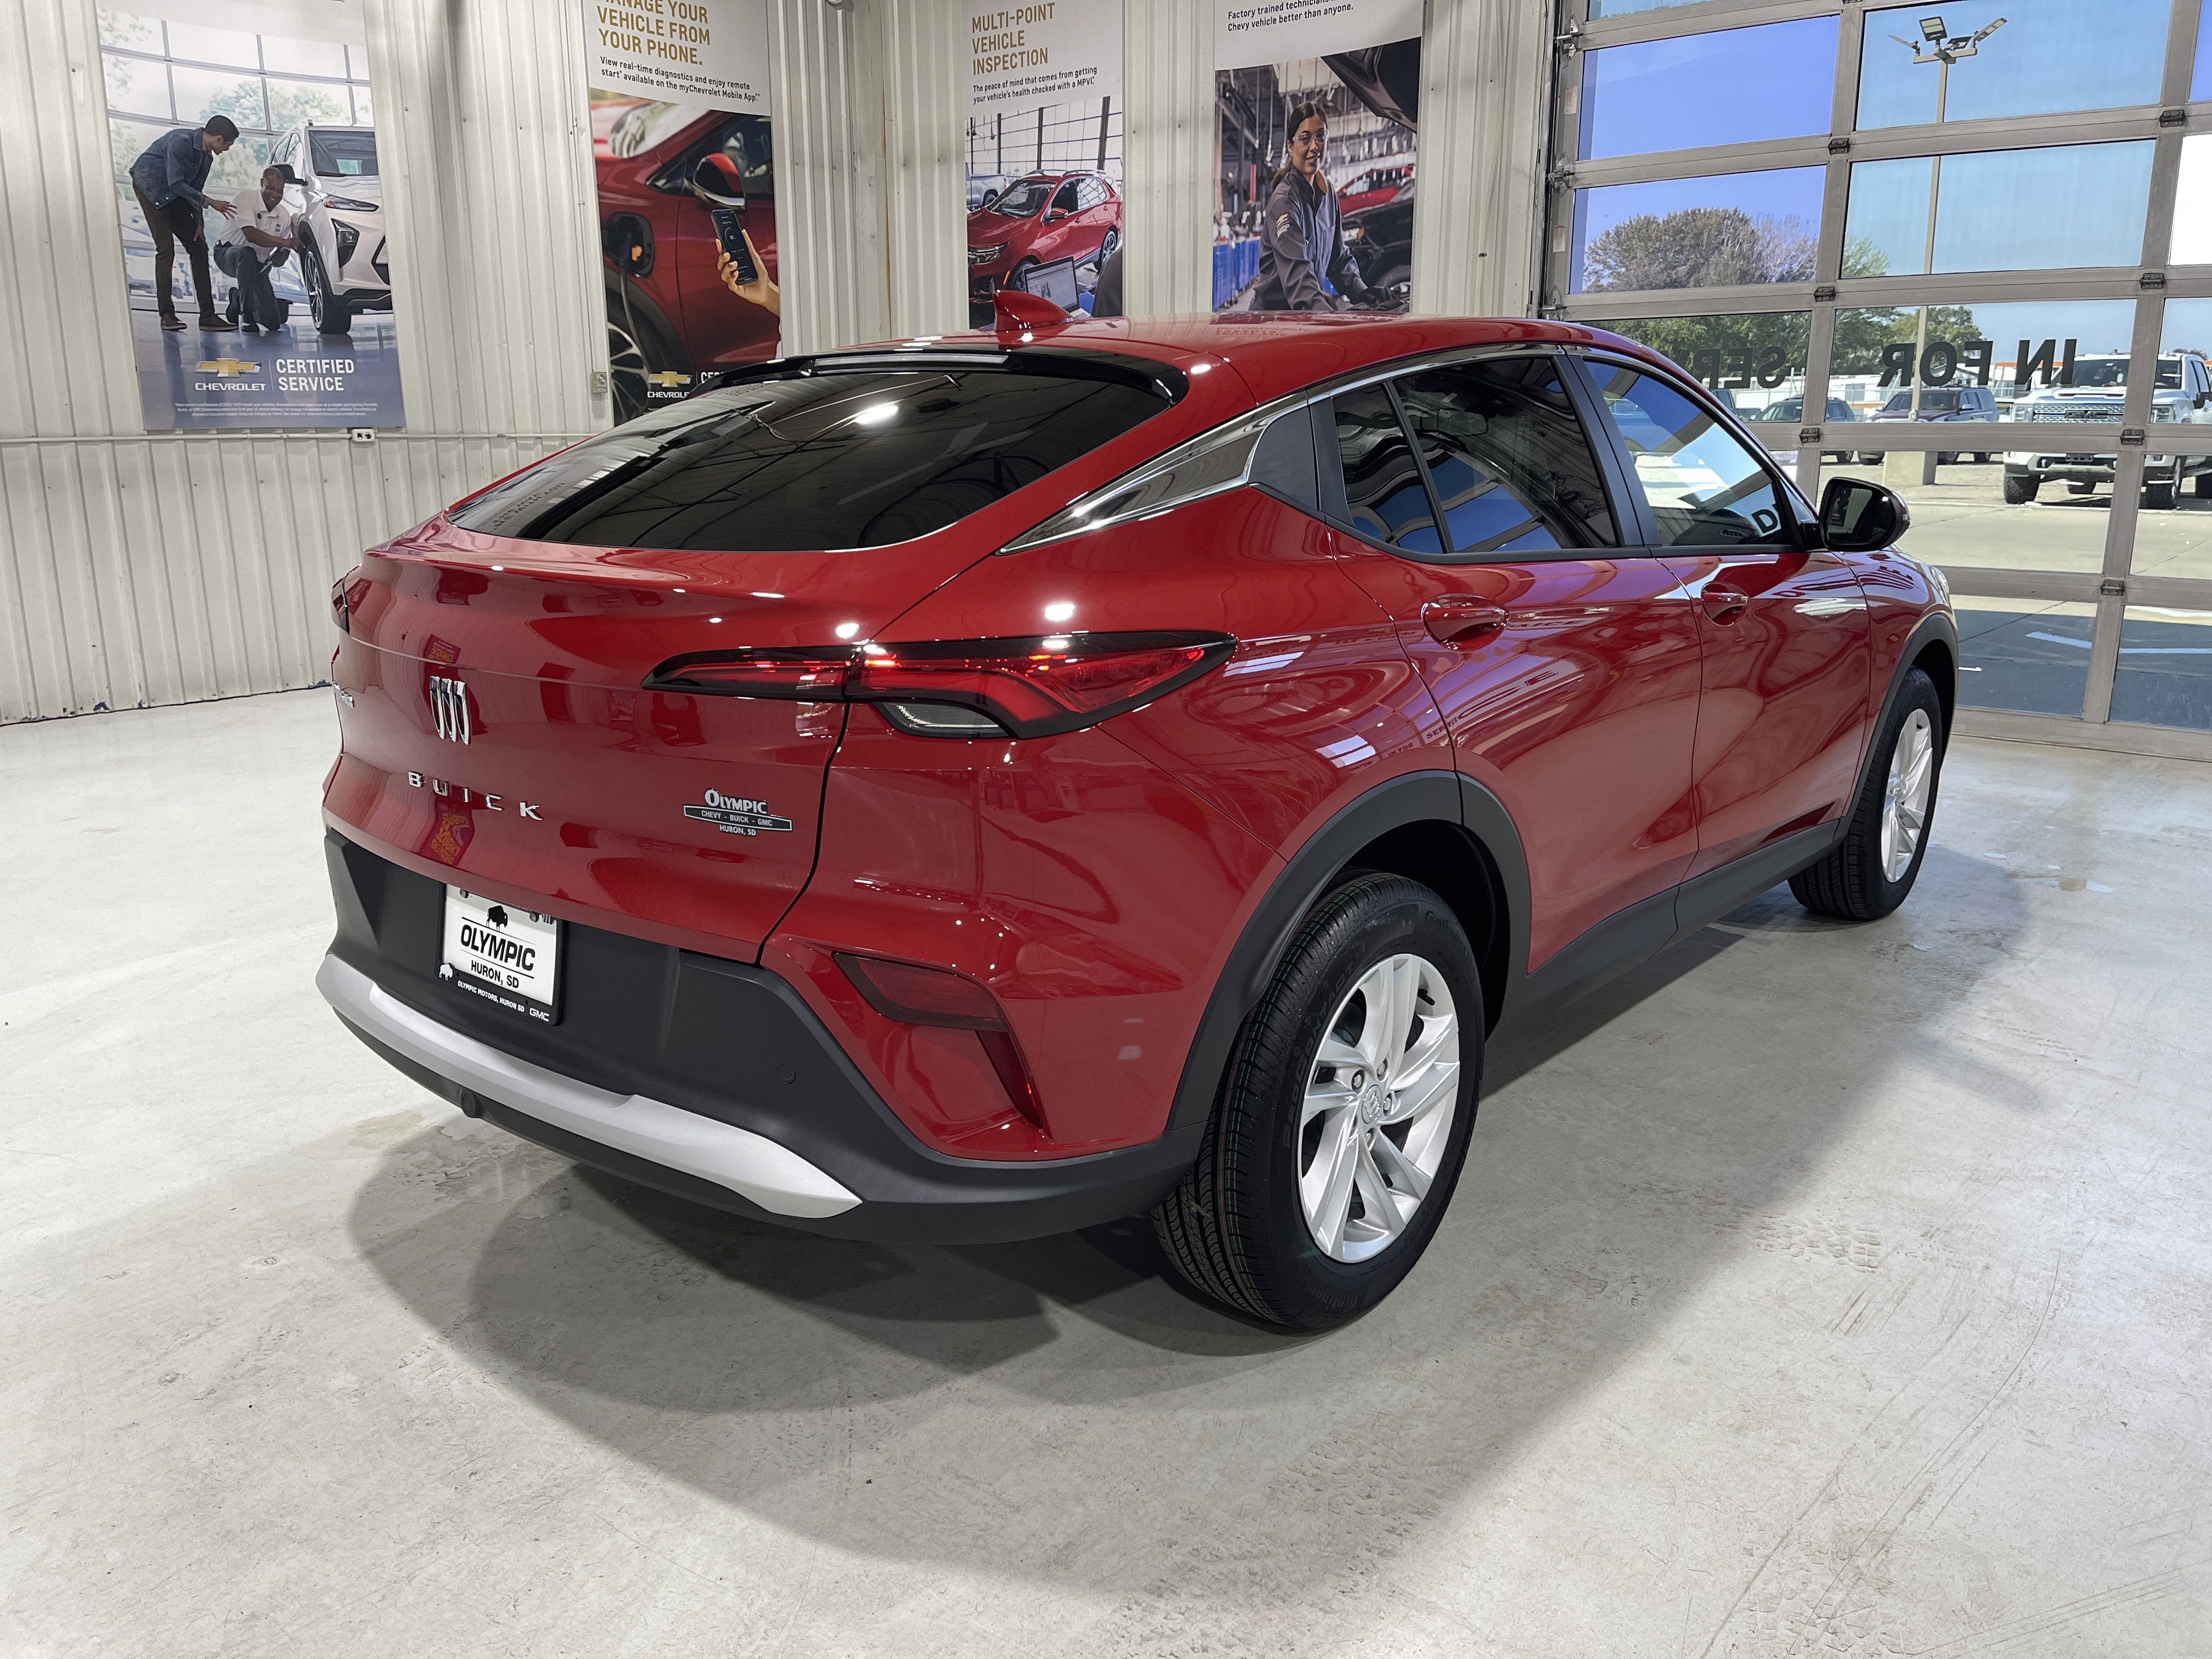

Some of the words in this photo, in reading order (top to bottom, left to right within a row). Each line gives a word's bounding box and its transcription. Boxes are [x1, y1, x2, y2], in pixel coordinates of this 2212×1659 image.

[606, 0, 664, 15] AGE
[668, 0, 708, 24] YOUR
[972, 2, 1056, 33] MULTI-POINT
[1228, 8, 1256, 20] Factory
[1257, 2, 1284, 15] trained
[1228, 21, 1250, 32] Chevy
[1251, 16, 1277, 28] vehicle
[1279, 12, 1302, 24] better
[1305, 9, 1322, 20] than
[1323, 3, 1354, 16] anyone.
[596, 5, 665, 37] VEHICLE
[669, 21, 710, 46] FROM
[598, 27, 642, 54] YOUR
[647, 38, 703, 65] PHONE.
[972, 30, 1025, 54] VEHICLE
[600, 55, 618, 67] View
[619, 61, 653, 74] real-time
[655, 67, 693, 81] diagnostics
[695, 76, 707, 84] and
[709, 77, 726, 88] enjoy
[727, 81, 750, 90] remote
[973, 47, 1048, 76] INSPECTION
[624, 73, 654, 85] available
[666, 81, 678, 89] the
[679, 84, 721, 97] myChevrolet
[722, 89, 742, 100] Mobile
[973, 84, 983, 93] The
[985, 83, 1001, 93] peace
[1002, 80, 1008, 88] of
[1009, 77, 1024, 87] mind
[1025, 76, 1037, 84] that
[1039, 74, 1057, 82] comes
[1059, 71, 1074, 80] from
[1075, 66, 1097, 78] getting
[973, 96, 986, 105] your
[987, 90, 1011, 102] vehicle's
[1012, 87, 1030, 98] health
[1031, 83, 1056, 94] checked
[1057, 81, 1070, 91] with
[275, 358, 355, 374] CERTIFIED
[194, 382, 267, 391] CHEVROLET
[278, 376, 345, 392] SERVICE
[408, 771, 543, 821] BUICK
[704, 789, 768, 815] OLYMPIC
[701, 810, 721, 819] CHEVY
[729, 814, 749, 823] BUICK
[758, 818, 773, 827] GMC
[719, 825, 746, 836] HURON,
[460, 924, 536, 972] OLYMPIC
[471, 960, 504, 986] HURON,
[506, 975, 520, 989] SD
[457, 980, 477, 994] OLYMPIC
[477, 988, 499, 1003] MOTORS,
[499, 997, 517, 1011] HURON
[517, 1004, 525, 1013] SD
[529, 1007, 550, 1022] GMC
